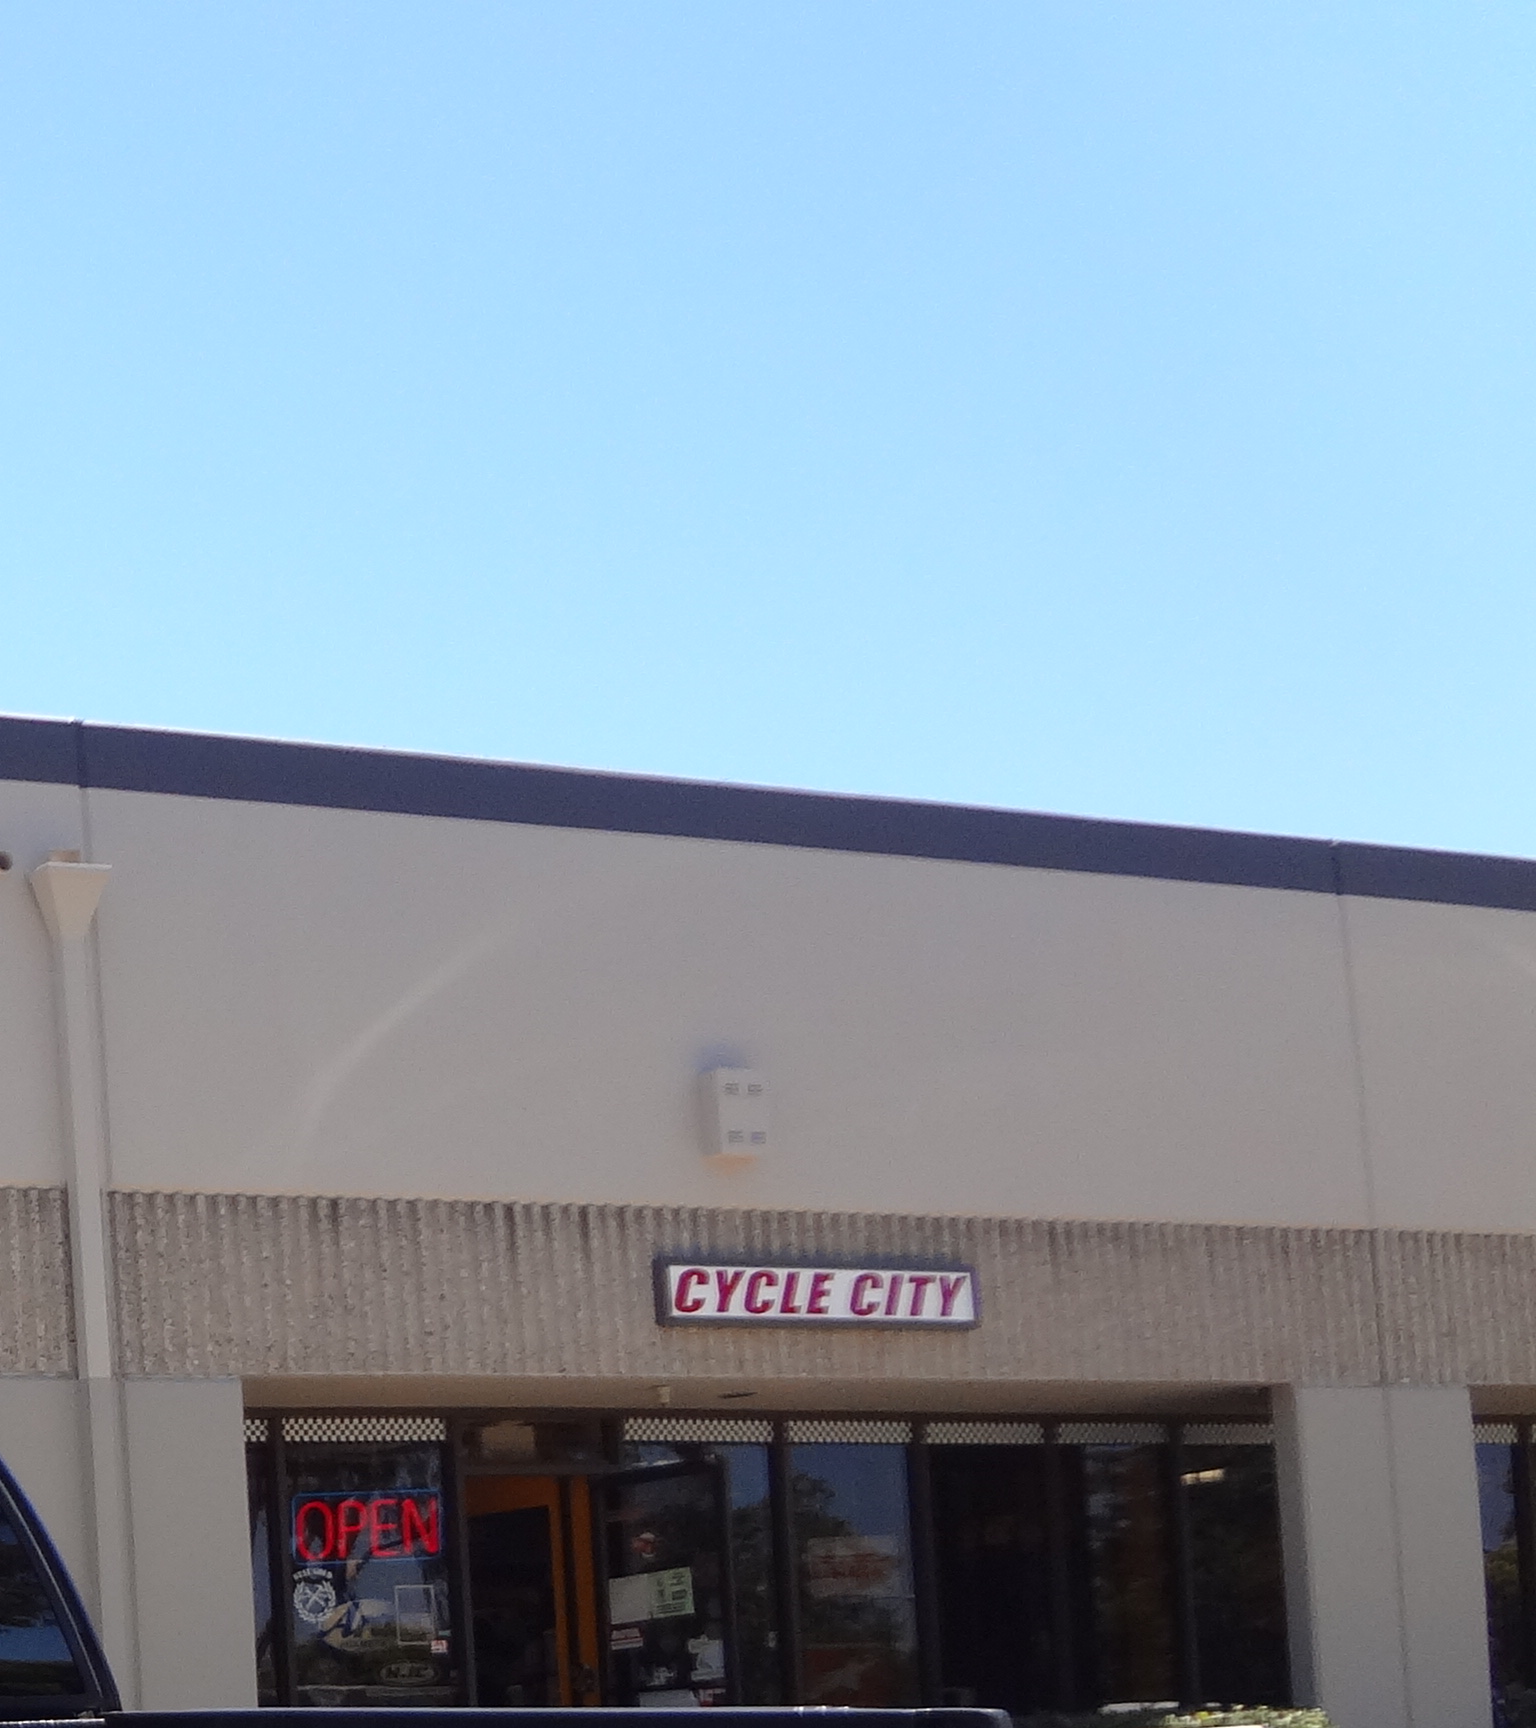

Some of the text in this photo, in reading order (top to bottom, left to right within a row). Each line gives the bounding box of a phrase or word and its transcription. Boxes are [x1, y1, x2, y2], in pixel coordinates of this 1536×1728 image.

[674, 1267, 967, 1317] CYCLE CITY
[295, 1496, 439, 1561] OPEN
